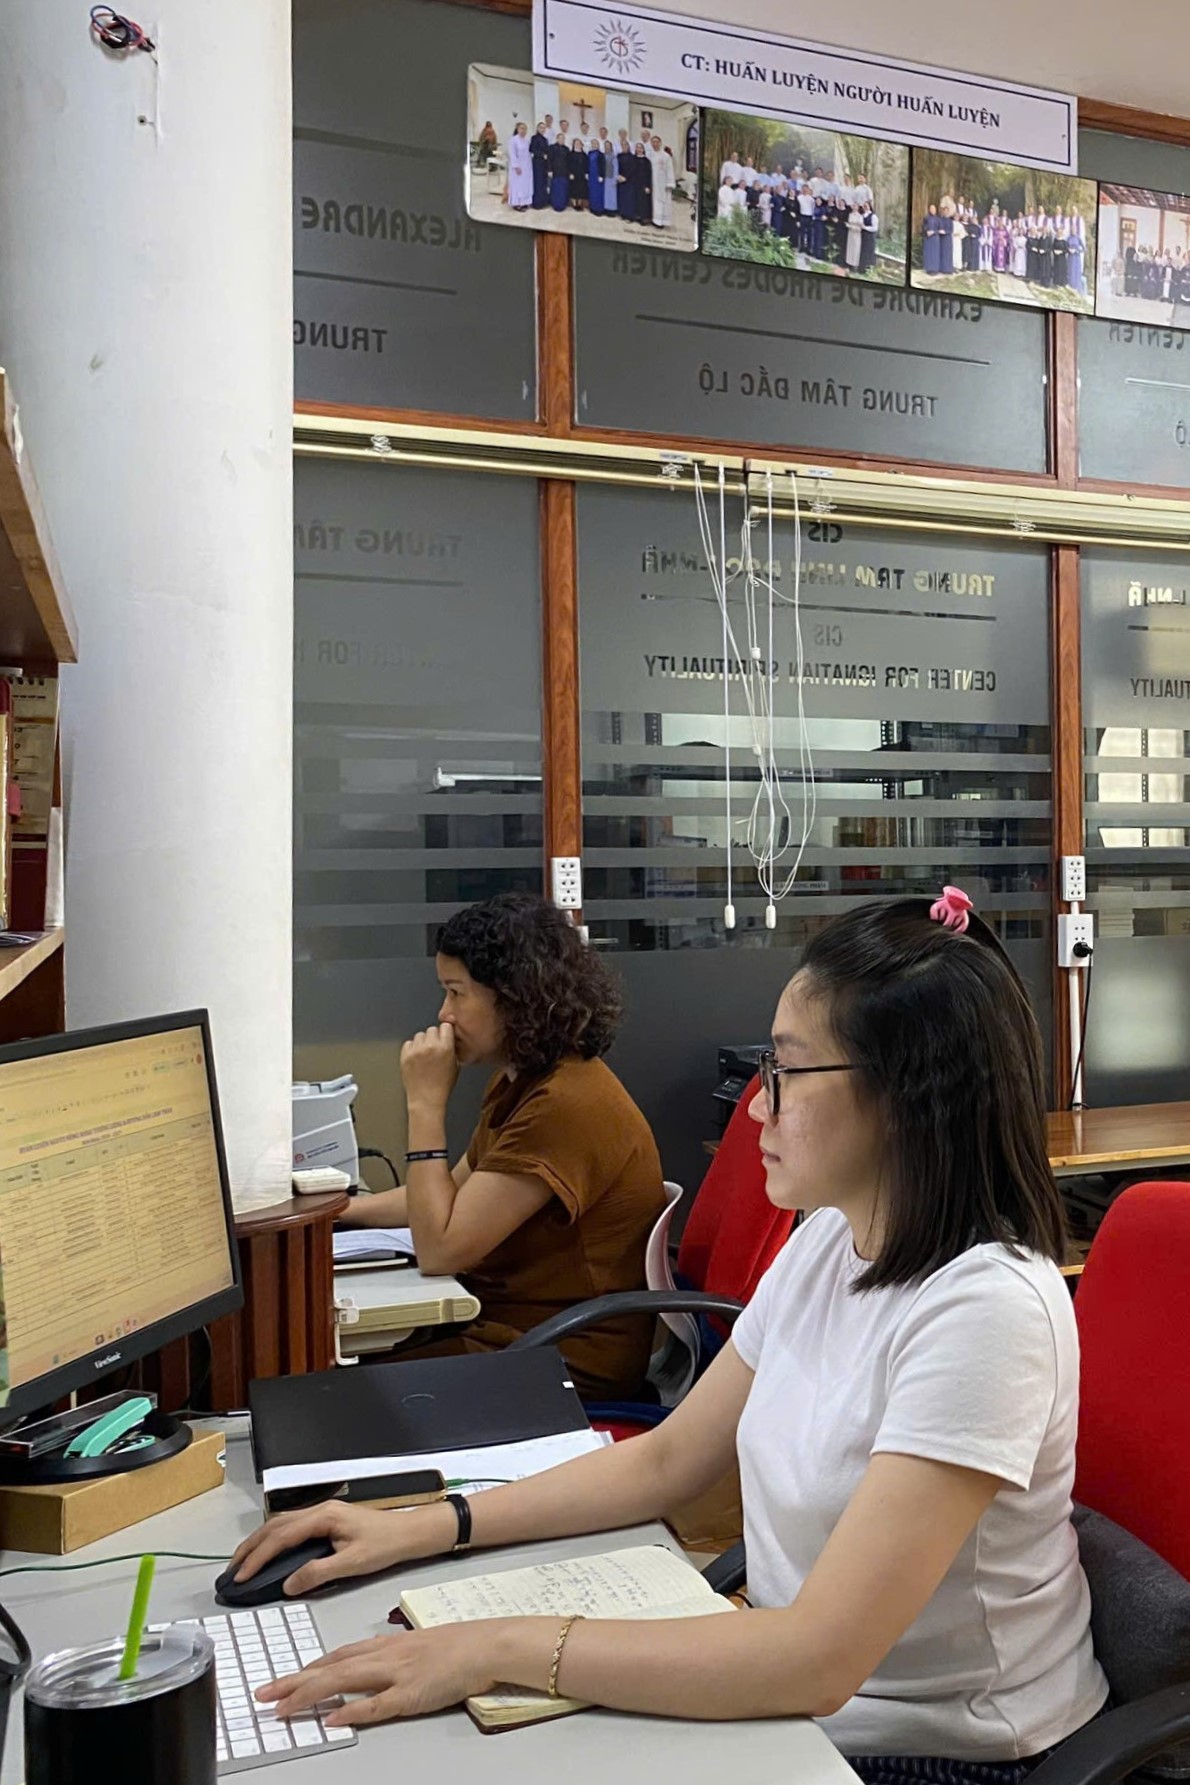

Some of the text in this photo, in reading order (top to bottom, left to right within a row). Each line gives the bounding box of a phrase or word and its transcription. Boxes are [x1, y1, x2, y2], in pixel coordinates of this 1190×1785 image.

[681, 53, 1001, 129] CT: HUẤN LUYỆN NGƯỜI HUẤN LUYỆN
